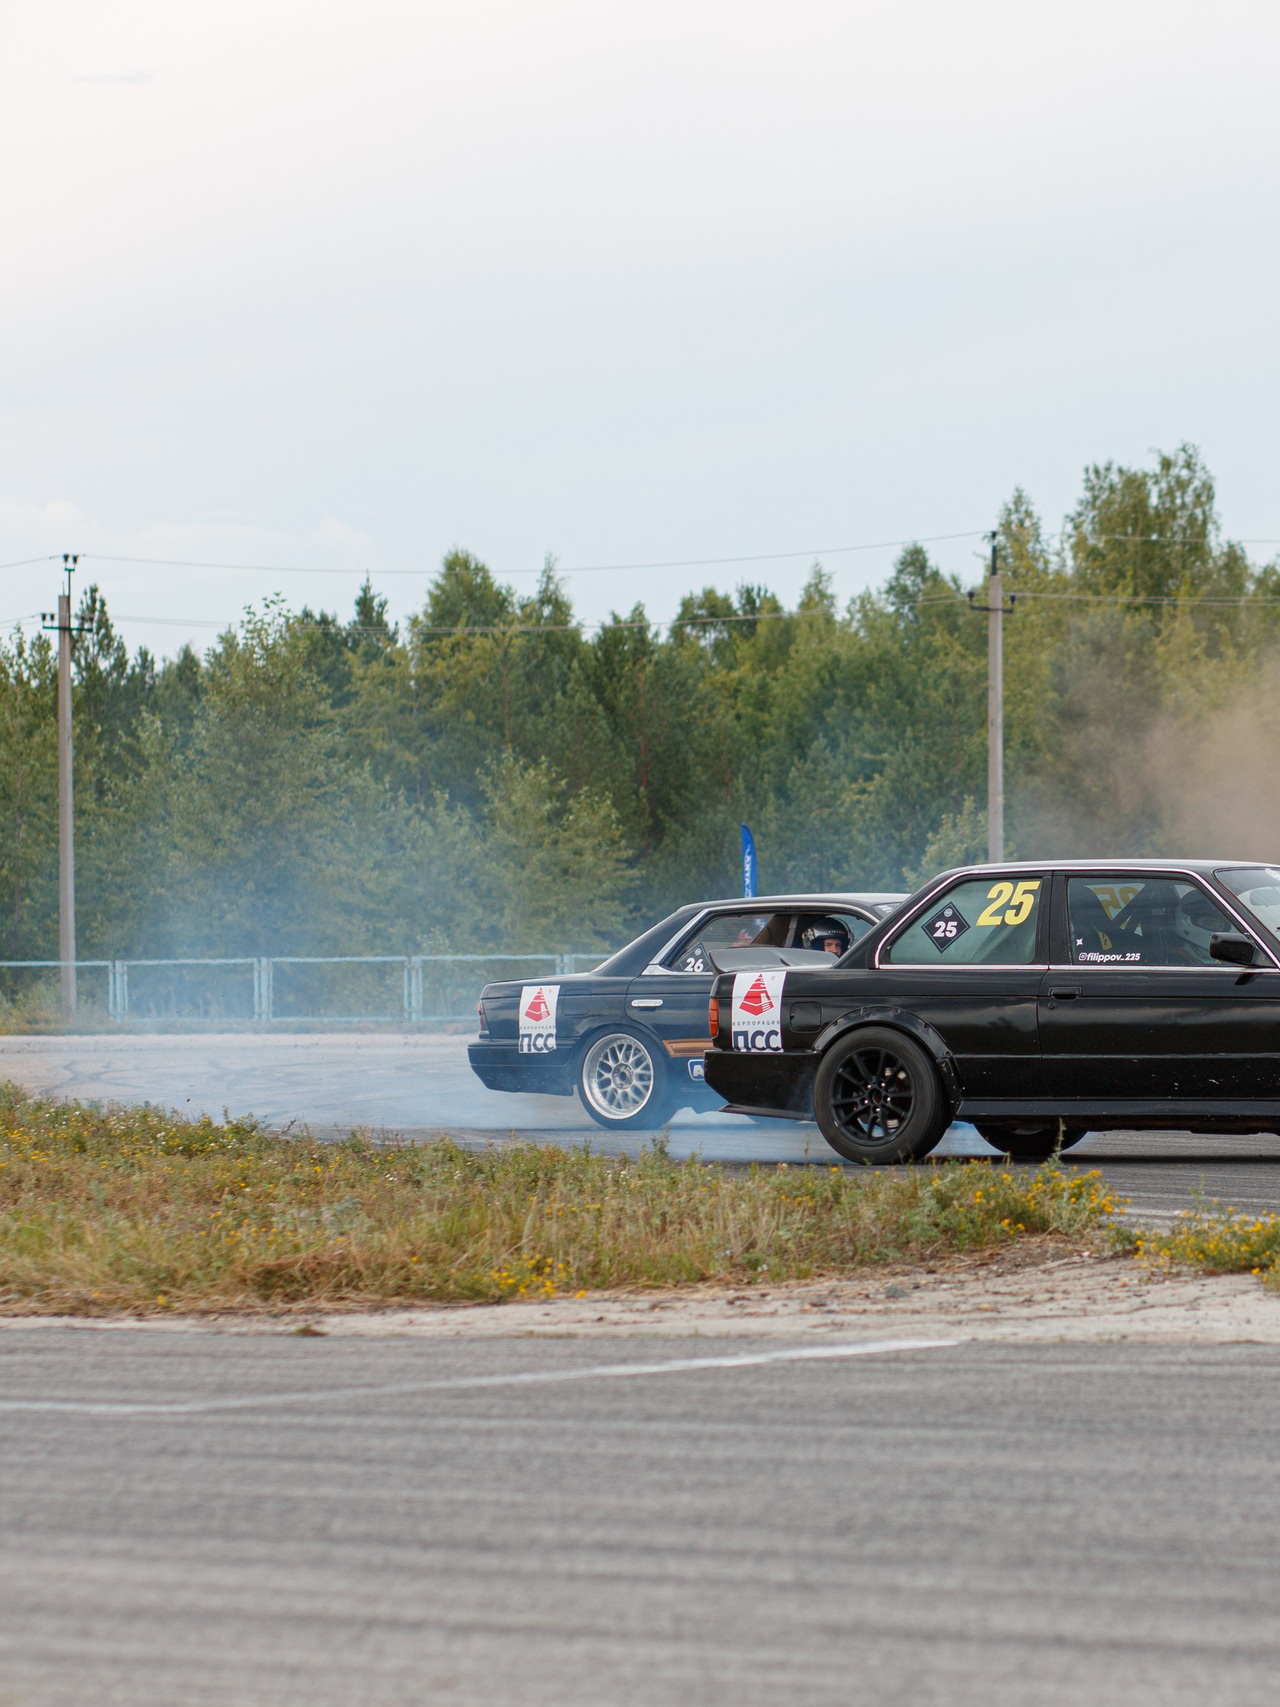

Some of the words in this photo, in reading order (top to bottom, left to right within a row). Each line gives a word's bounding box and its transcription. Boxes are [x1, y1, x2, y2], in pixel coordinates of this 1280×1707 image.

[975, 880, 1041, 927] 25
[932, 921, 958, 938] 25
[684, 957, 704, 973] 26
[519, 1033, 555, 1053] ПСС
[733, 1029, 782, 1053] ПСС
